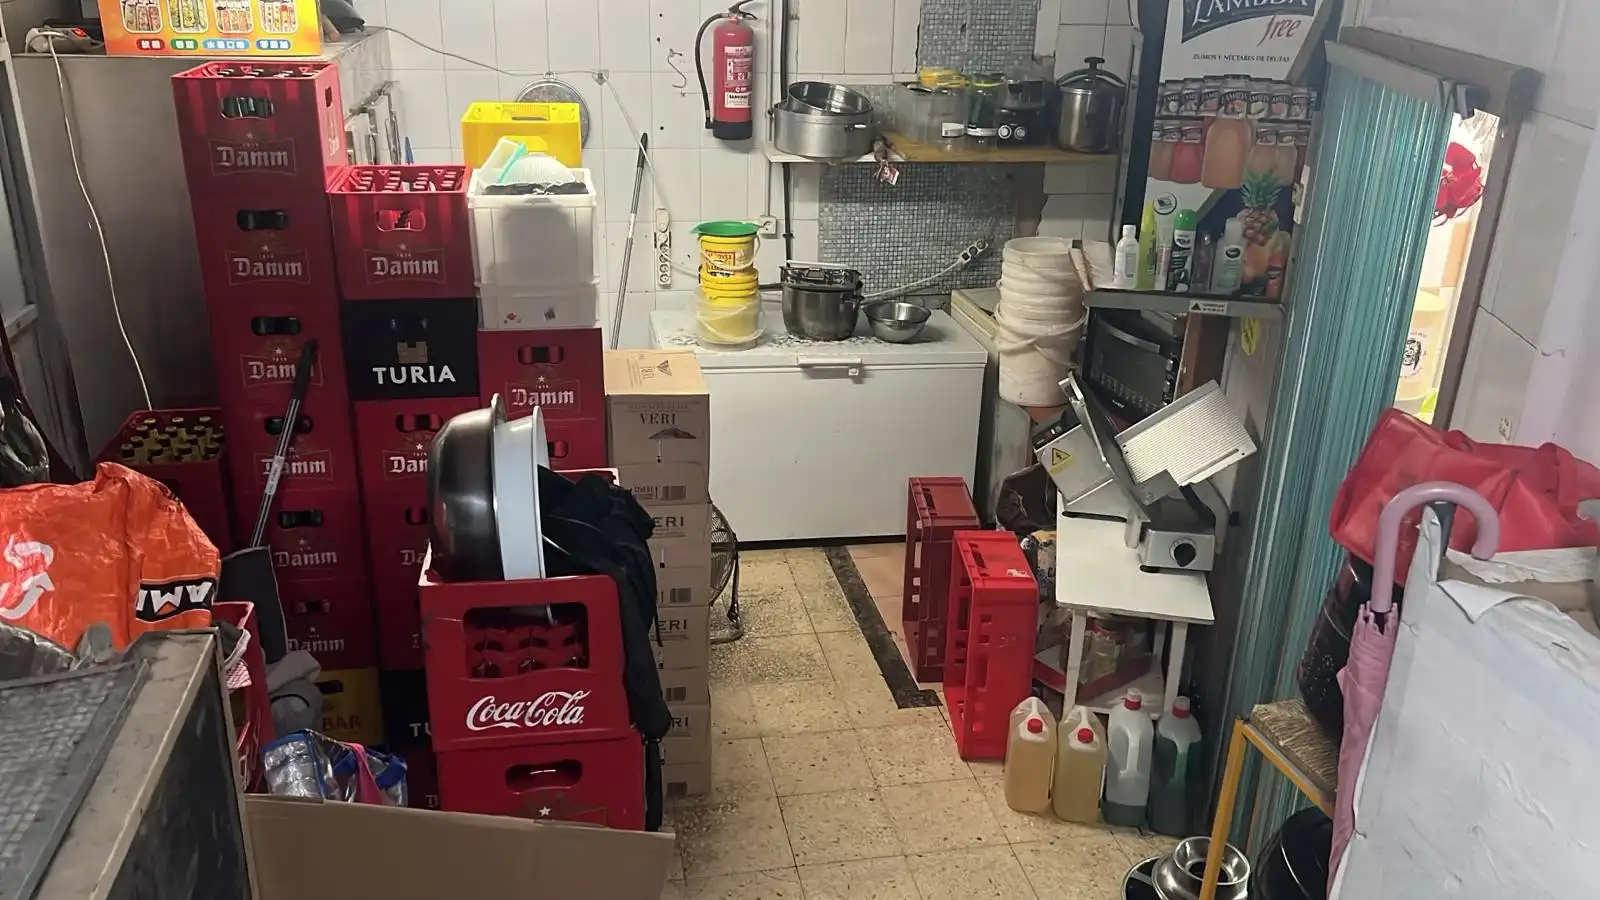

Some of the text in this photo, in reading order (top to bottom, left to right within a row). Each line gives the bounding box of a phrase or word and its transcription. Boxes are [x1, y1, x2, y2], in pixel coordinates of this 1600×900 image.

[216, 146, 288, 167] Damm
[232, 257, 302, 276] Damm
[371, 256, 439, 276] Damm
[248, 361, 314, 379] Dam
[372, 365, 456, 384] TURIA
[511, 388, 574, 406] Damm
[640, 413, 676, 425] VERI
[653, 516, 684, 527] ERI
[274, 551, 337, 567] Damm
[400, 549, 426, 566] Da
[656, 619, 687, 631] ERI
[466, 690, 591, 731] Coca-Cola
[322, 715, 361, 730] BAR
[671, 716, 689, 728] RI
